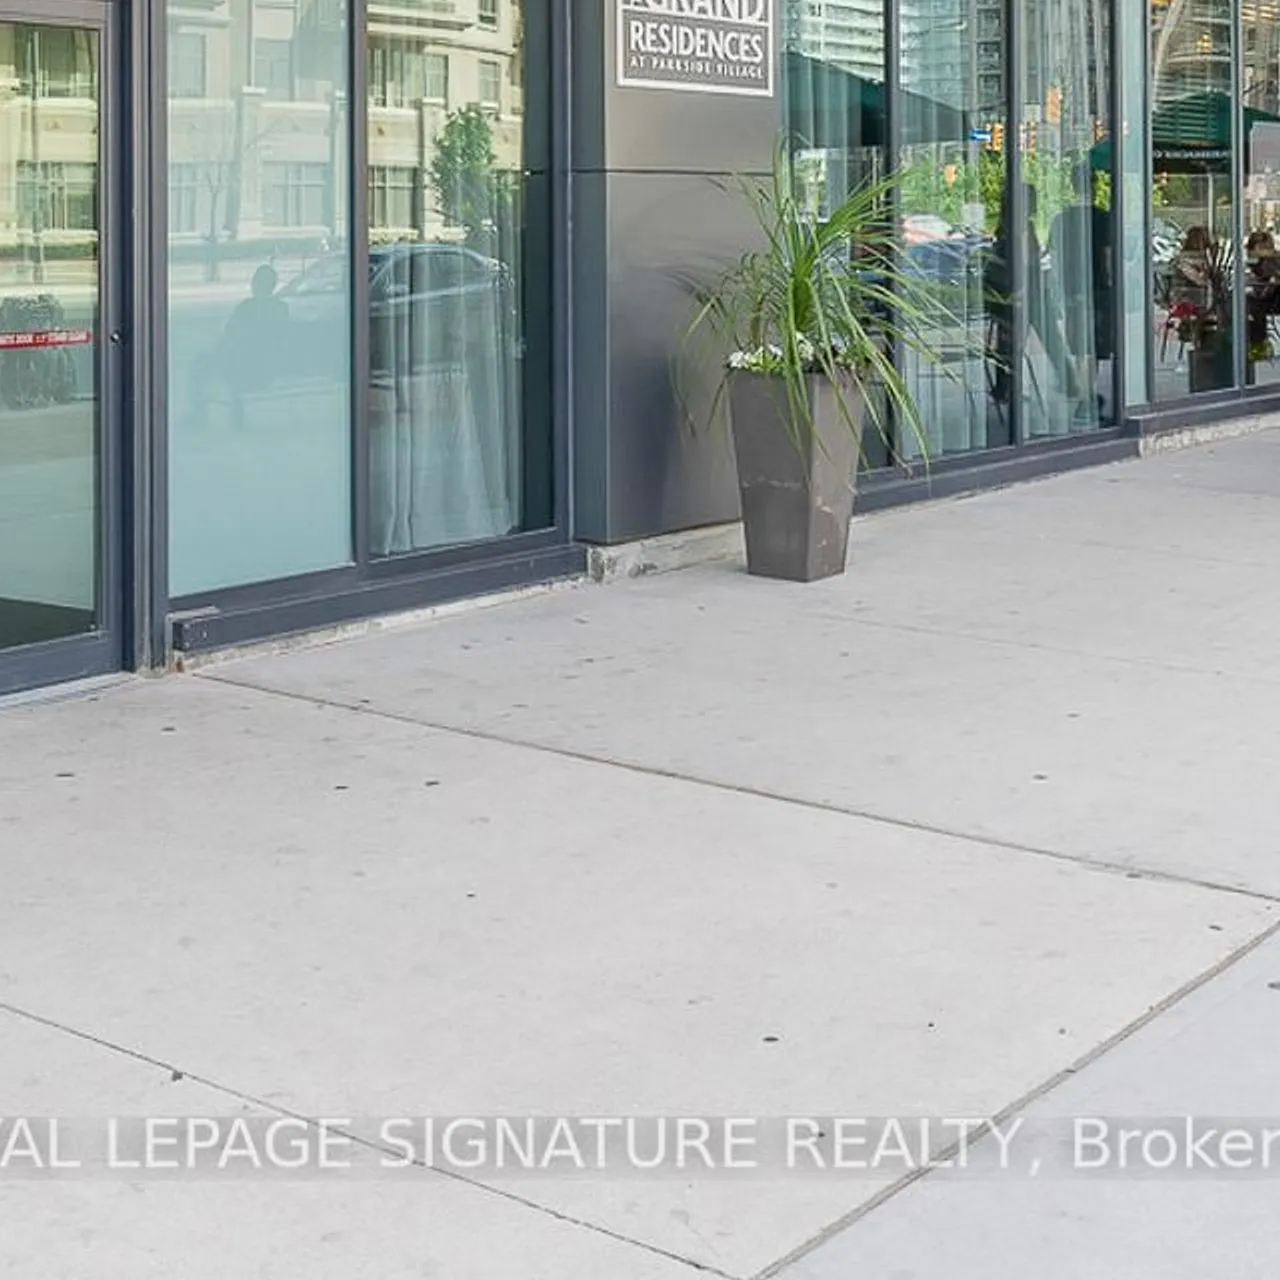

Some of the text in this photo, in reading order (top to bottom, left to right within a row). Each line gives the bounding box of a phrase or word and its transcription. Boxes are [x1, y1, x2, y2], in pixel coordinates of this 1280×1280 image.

[630, 20, 763, 63] RESIDENCES
[630, 56, 644, 68] AT
[652, 58, 711, 74] PARKSIDE
